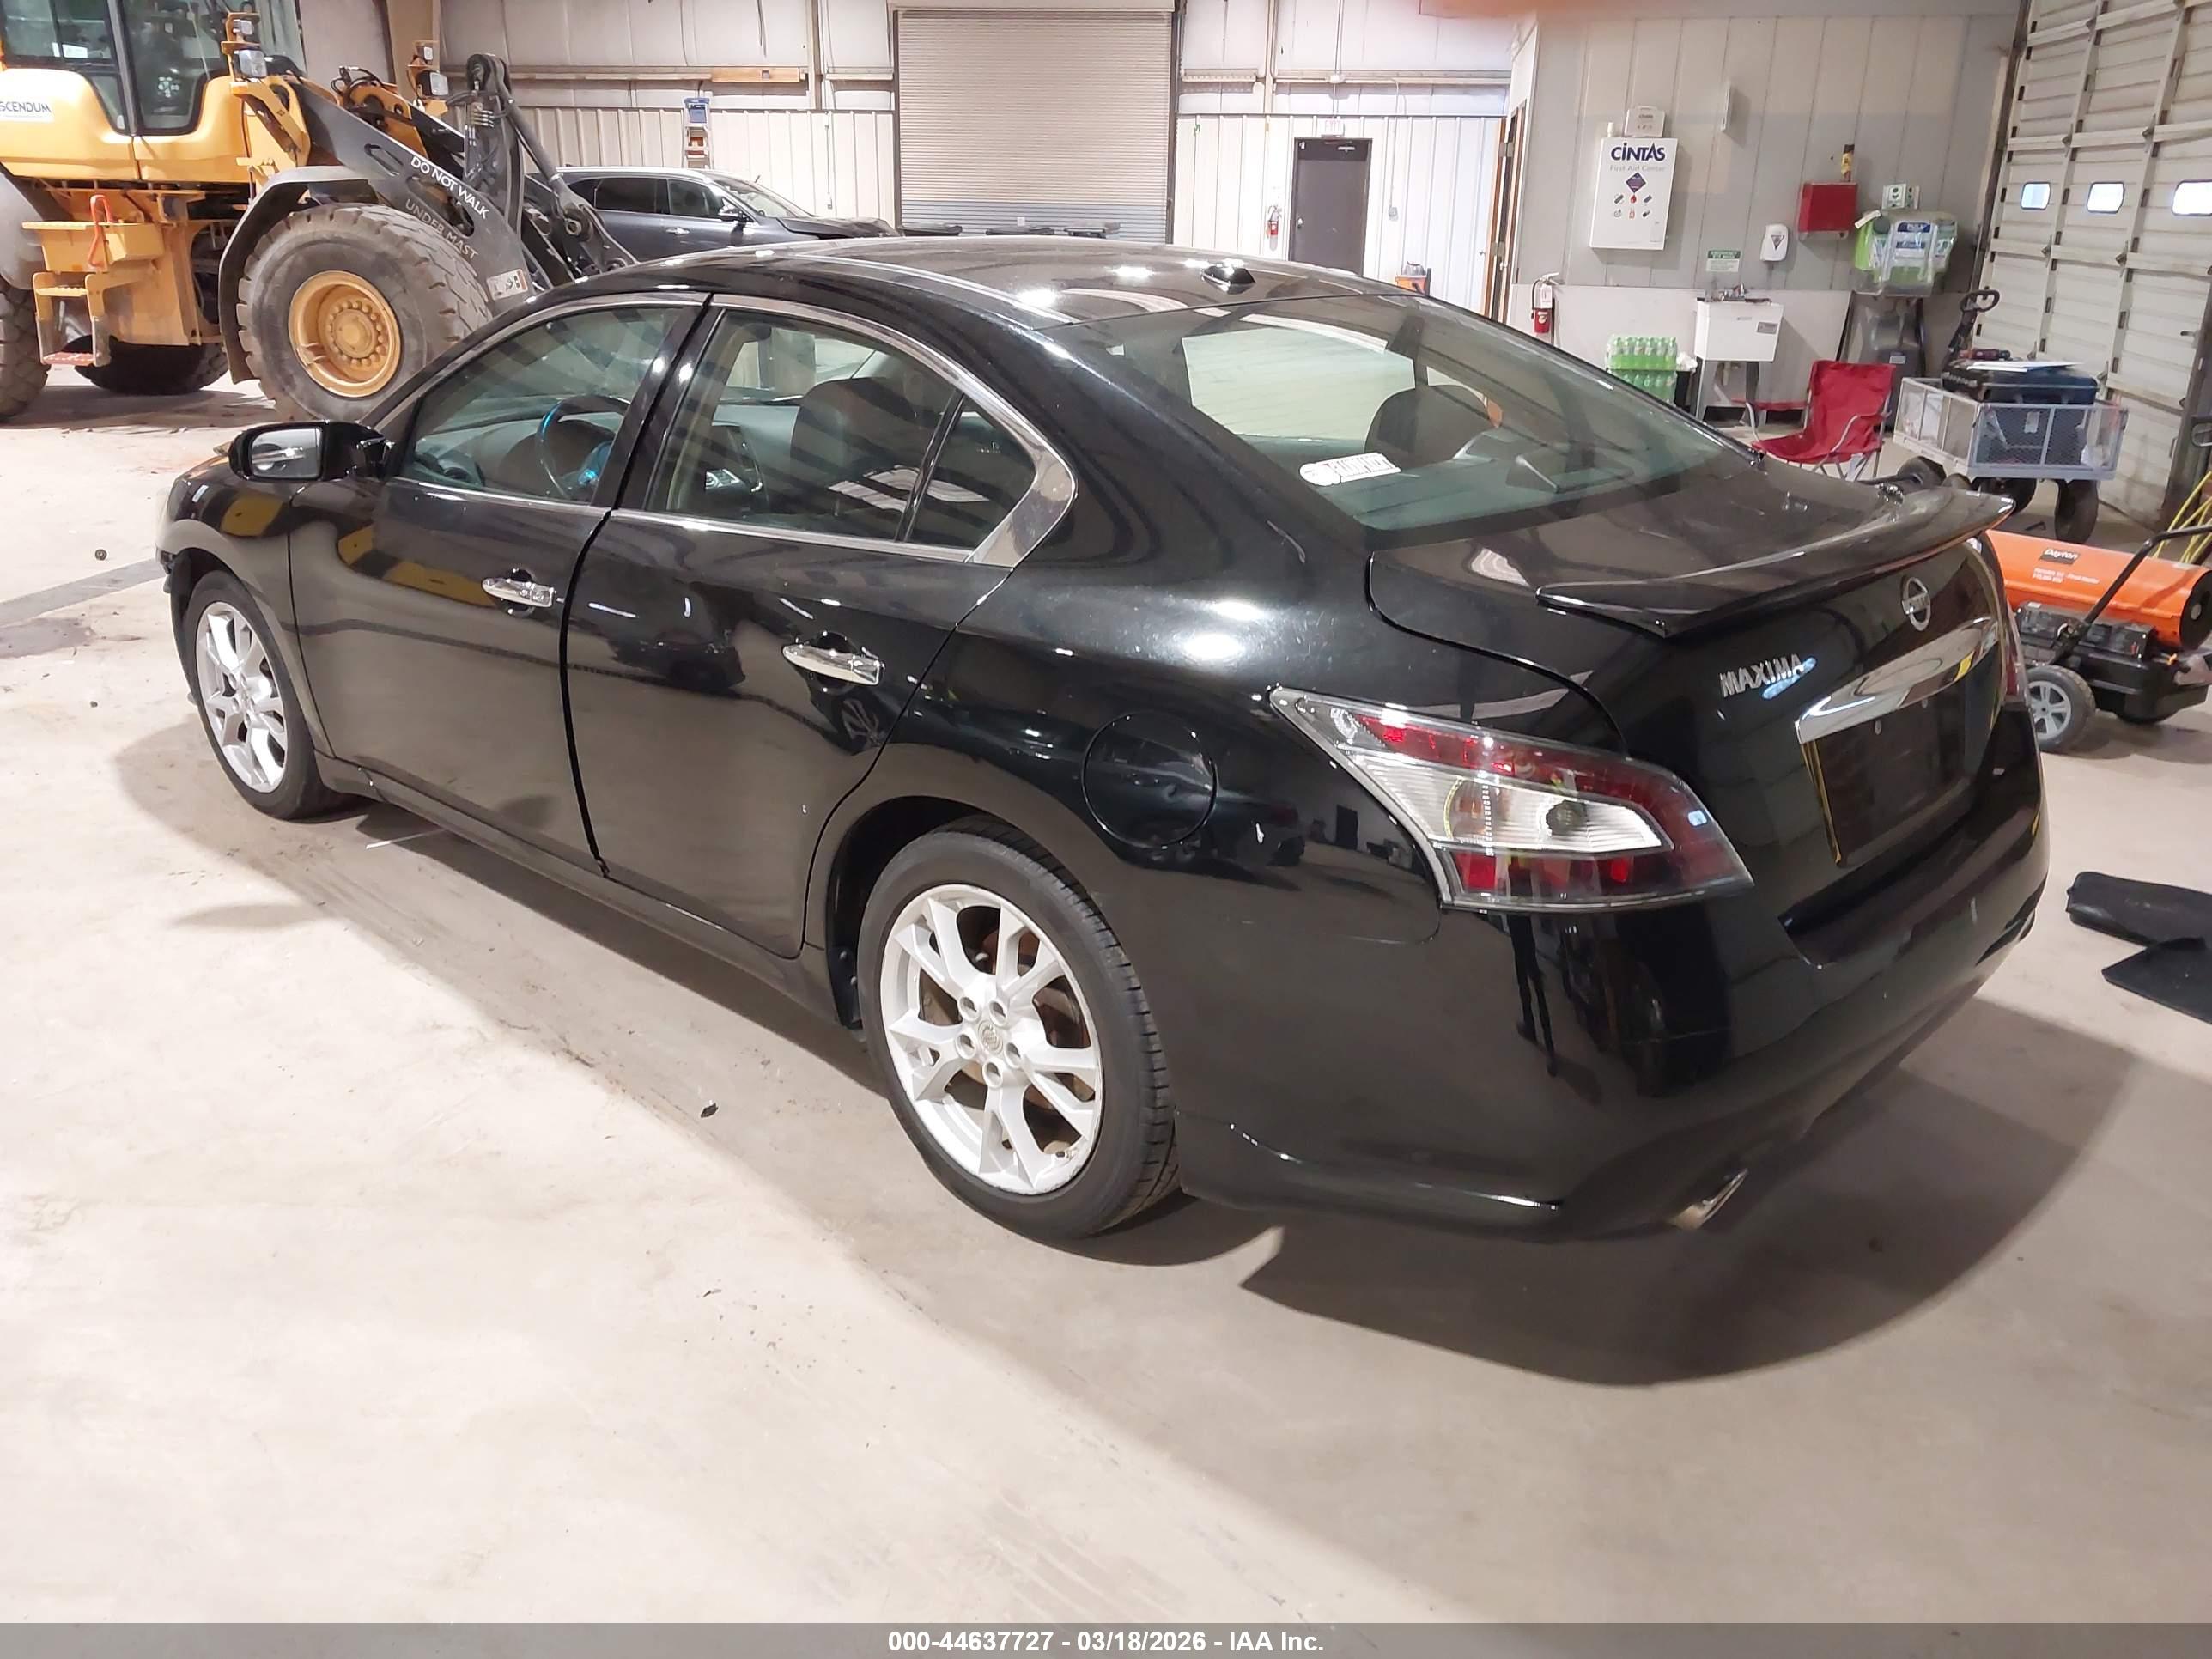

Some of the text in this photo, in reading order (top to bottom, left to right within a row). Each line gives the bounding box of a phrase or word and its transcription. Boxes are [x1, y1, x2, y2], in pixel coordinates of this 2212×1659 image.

[410, 155, 489, 220] DO NOT WALK
[446, 232, 478, 259] MAST
[1719, 653, 1803, 698] MAXIMA
